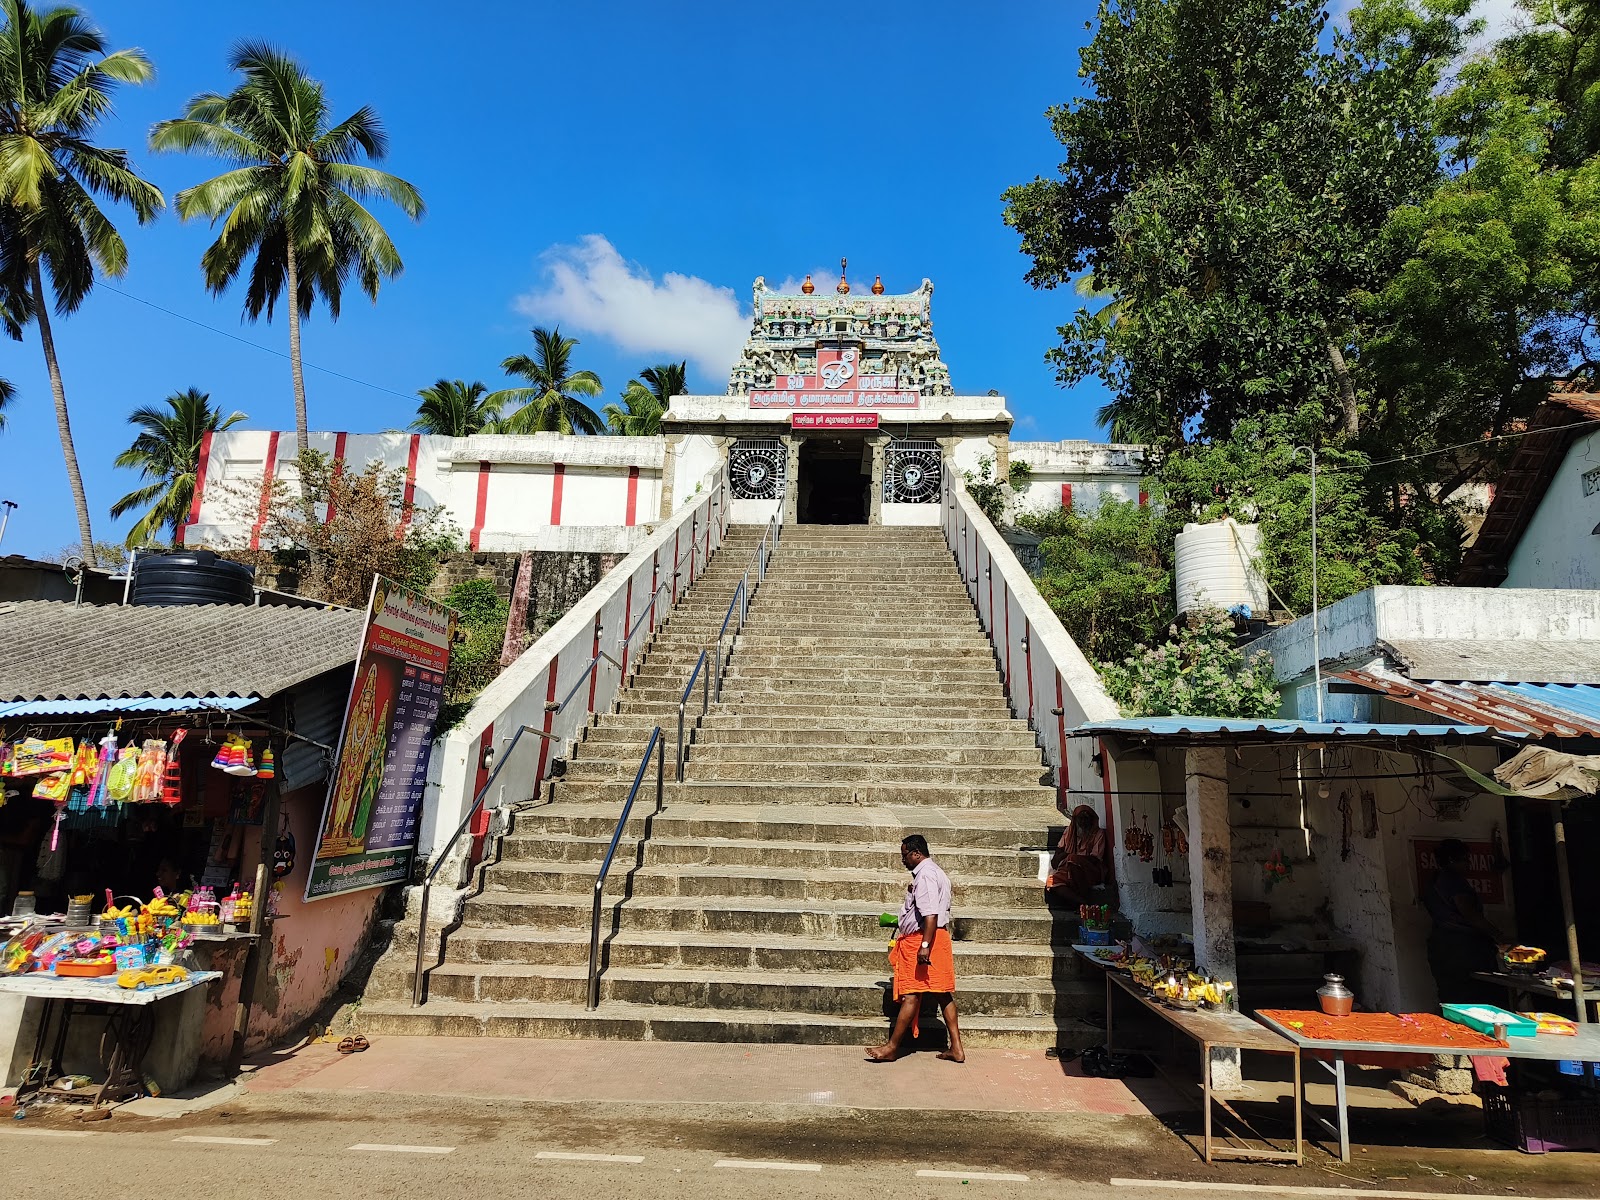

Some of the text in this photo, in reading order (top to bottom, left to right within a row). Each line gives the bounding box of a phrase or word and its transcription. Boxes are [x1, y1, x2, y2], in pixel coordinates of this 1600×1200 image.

[753, 392, 915, 407] அருள்மிகு குமாரசுவாமி திருக்கோயில்
